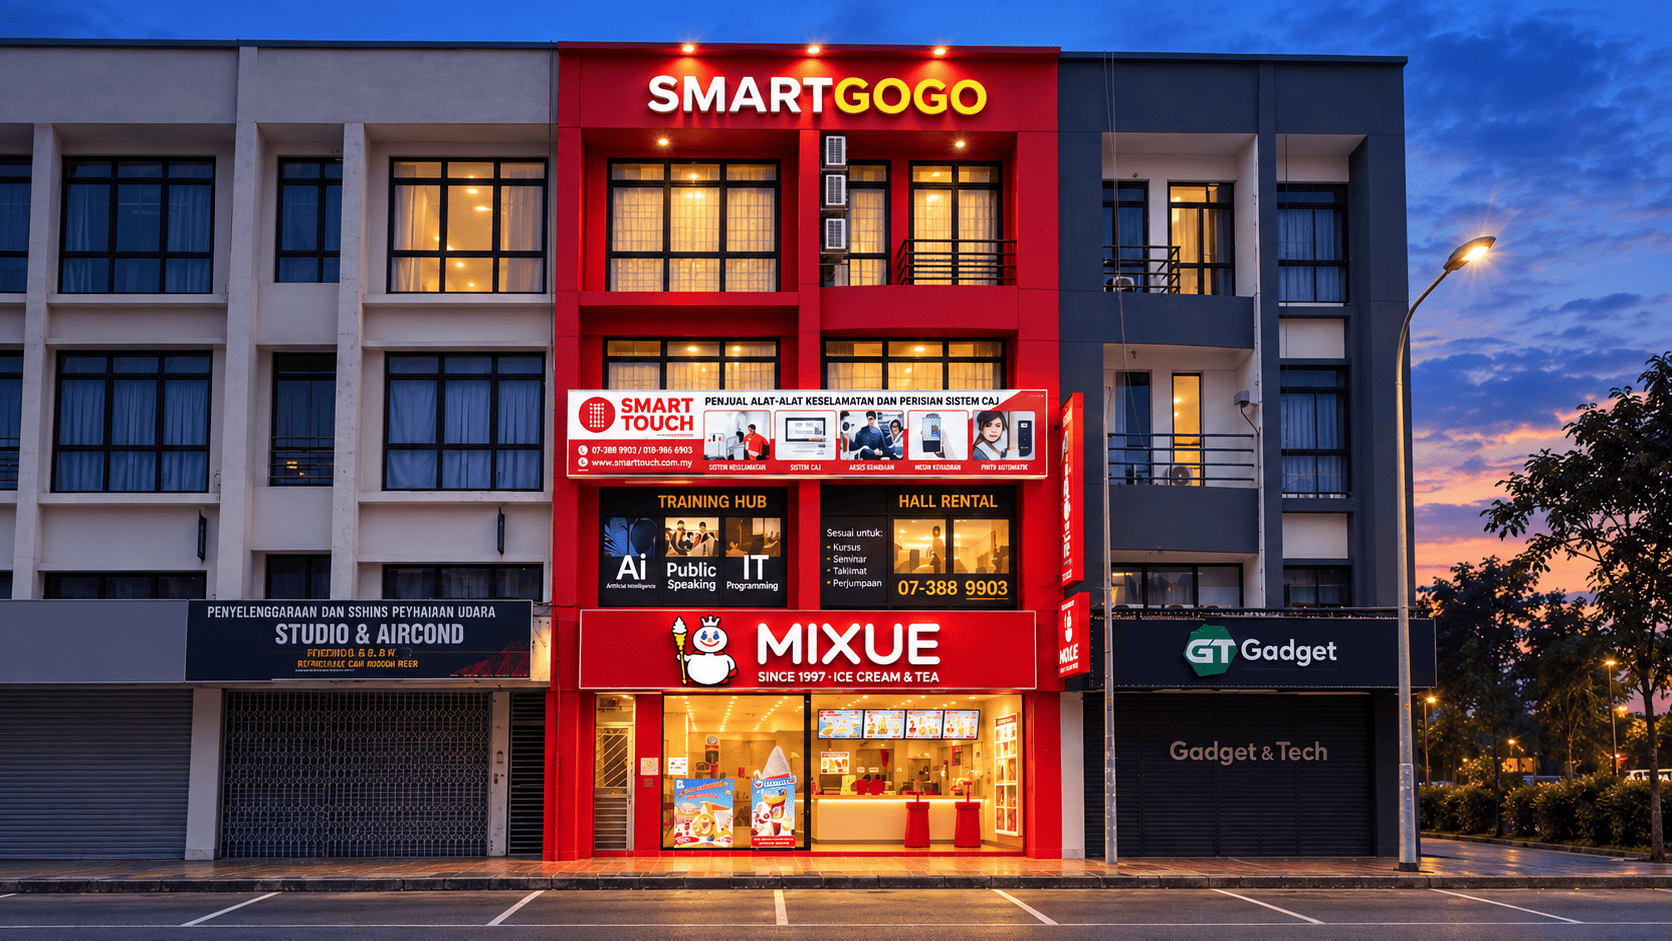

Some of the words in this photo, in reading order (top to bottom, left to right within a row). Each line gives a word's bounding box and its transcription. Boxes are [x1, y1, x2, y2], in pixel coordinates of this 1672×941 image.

[648, 75, 988, 115] SMARTGOGO
[621, 398, 694, 413] SMART
[705, 397, 748, 406] PENJUAL
[751, 397, 803, 406] ALAT-ALAT
[805, 396, 873, 406] KESELAMATAN
[877, 396, 897, 406] DAN
[900, 396, 943, 406] PERISIAN
[946, 396, 979, 406] SISTEM
[982, 396, 999, 406] CAJ
[621, 415, 694, 431] TOUCH
[591, 458, 693, 468] www.smarttouch.com.my
[657, 495, 730, 509] TRAINING
[735, 495, 767, 509] HUB
[899, 494, 937, 508] HALL
[941, 494, 998, 508] RENTAL
[826, 528, 854, 537] Sesuai
[856, 528, 883, 537] untuk:
[833, 543, 862, 552] Kursus
[833, 554, 867, 564] Seminar
[616, 553, 646, 580] Ai
[667, 562, 717, 577] Public
[743, 555, 769, 580] IT
[667, 580, 717, 591] Speaking
[726, 581, 779, 592] Programming
[833, 579, 883, 589] Perjumpaan
[898, 580, 958, 596] 07-388
[965, 580, 1008, 596] 9903
[207, 606, 318, 618] PENYELENGGARAAN
[322, 606, 345, 618] DAN
[348, 606, 388, 618] SSHINS
[458, 606, 496, 618] UDARA
[275, 623, 349, 645] STUDIO
[355, 623, 370, 645] &
[376, 623, 464, 645] AIRCOND
[757, 623, 941, 665] MIXUE
[1185, 639, 1236, 663] GT
[1241, 639, 1337, 666] Gadget
[758, 672, 795, 682] SINCE
[798, 672, 826, 682] 1997
[833, 672, 853, 682] ICE
[856, 672, 900, 682] CREAM
[903, 672, 912, 682] &
[915, 672, 939, 682] TEA
[1169, 741, 1257, 766] Gadget
[1261, 746, 1273, 761] &
[1276, 741, 1328, 761] Tech
